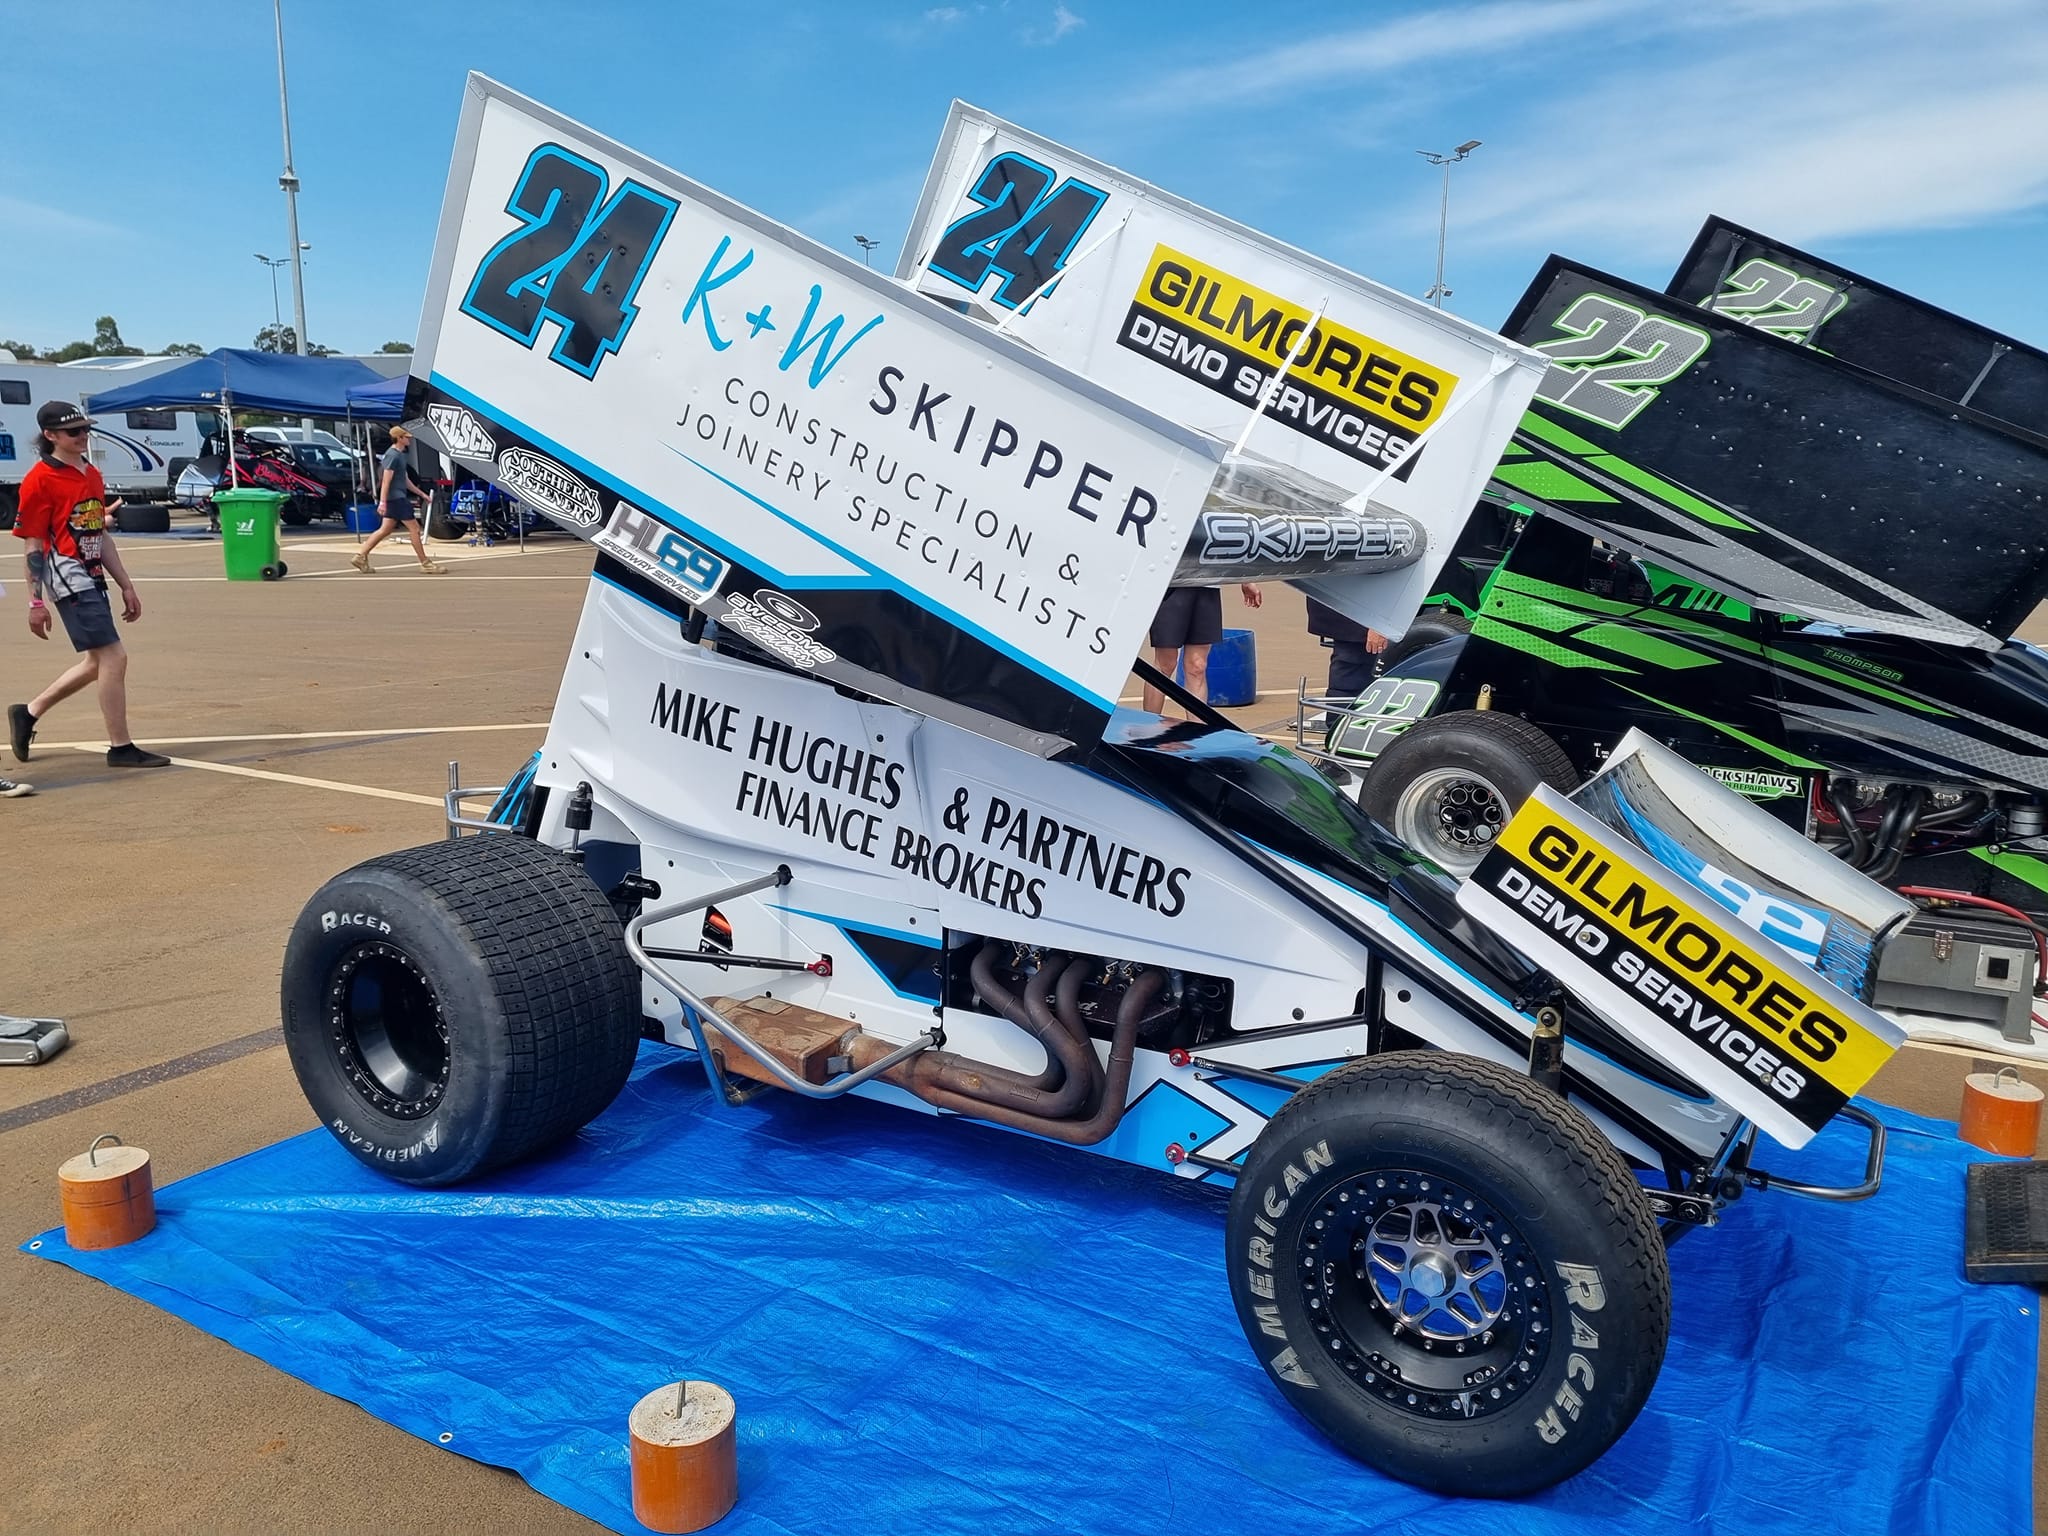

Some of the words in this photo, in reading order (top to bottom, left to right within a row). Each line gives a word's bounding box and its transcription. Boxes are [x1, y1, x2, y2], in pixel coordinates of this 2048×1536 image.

[460, 142, 681, 381] 24
[928, 151, 1110, 317] 24
[1697, 258, 1848, 356] 22
[1130, 314, 1228, 377] DEMO
[1234, 366, 1412, 466] SERVICES
[1149, 260, 1440, 422] GILMORES
[1534, 293, 1711, 431] 22
[429, 407, 494, 453] FELSCH
[504, 467, 593, 527] FASTENERS
[510, 448, 599, 511] SOUTHERN
[725, 378, 1033, 559] CONSTRUCTION
[1058, 553, 1080, 585] &
[869, 366, 1158, 548] SKIPPER
[599, 537, 653, 574] SPEEDWAY
[653, 564, 701, 602] SERVICES
[608, 502, 723, 592] HL69
[677, 404, 831, 500] JOINERY
[847, 496, 1111, 655] SPECIALISTS
[1201, 512, 1416, 563] SKIPPER
[1328, 677, 1441, 758] 22
[1824, 647, 1903, 682] THOMPSON
[650, 682, 740, 752] MIKE
[748, 715, 905, 810] HUGHES
[943, 786, 970, 833] &
[981, 796, 1191, 919] PARTNERS
[735, 771, 883, 859] FINANCE
[892, 825, 1046, 919] BROKERS
[1702, 767, 1798, 793] ACKSHAWS
[1497, 868, 1609, 955] DEMO
[1611, 951, 1807, 1100] SERVICES
[1528, 825, 1848, 1063] GILMORES
[1248, 1139, 1336, 1389] AMERICAN
[1535, 1260, 1607, 1445] RACER
